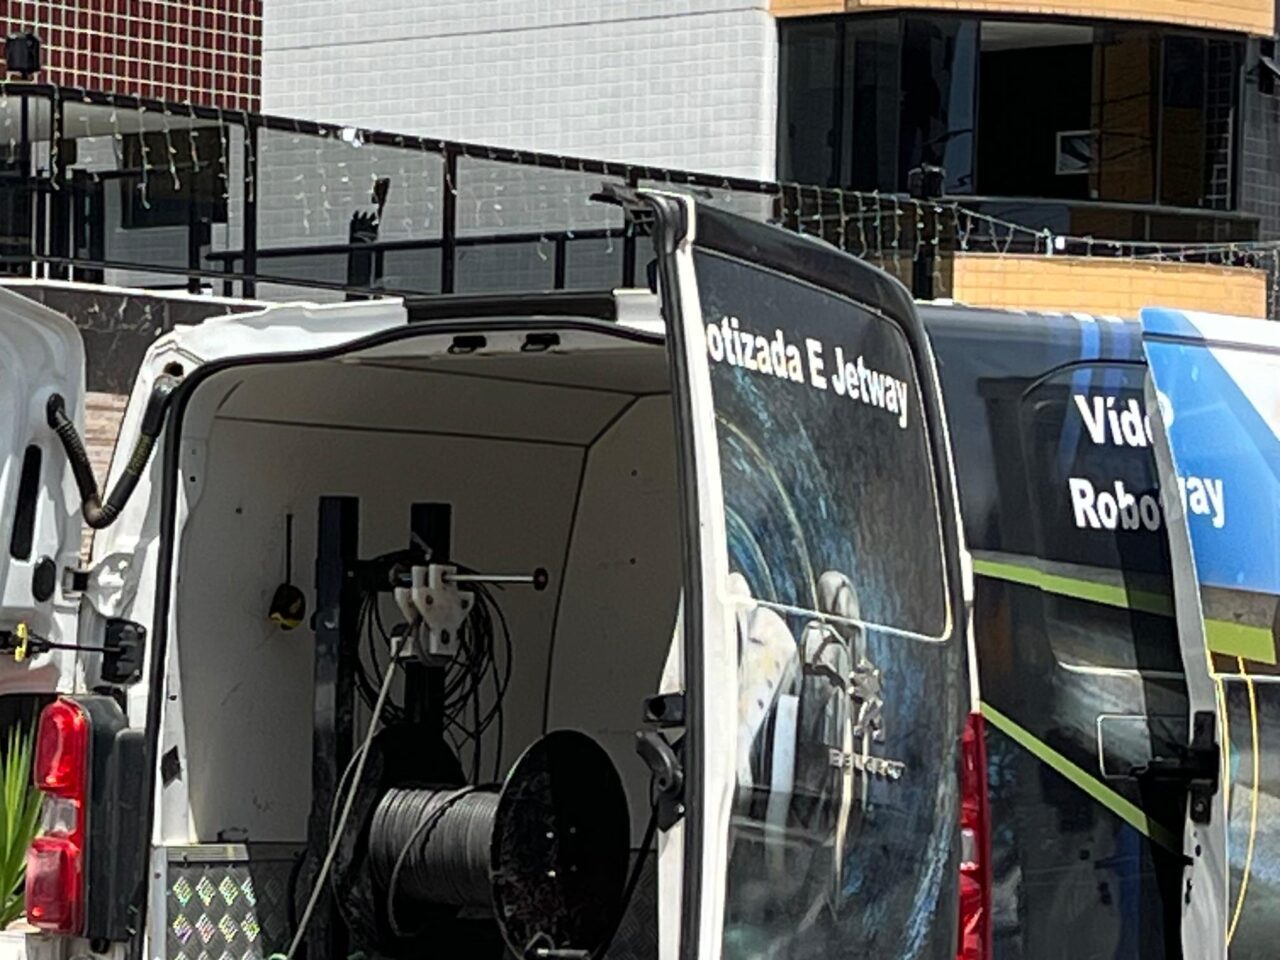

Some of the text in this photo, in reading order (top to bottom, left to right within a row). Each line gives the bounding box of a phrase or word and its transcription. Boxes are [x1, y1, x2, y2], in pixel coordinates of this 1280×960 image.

[805, 337, 828, 390] E
[831, 347, 908, 429] Jetway
[1068, 477, 1161, 531] Robo
